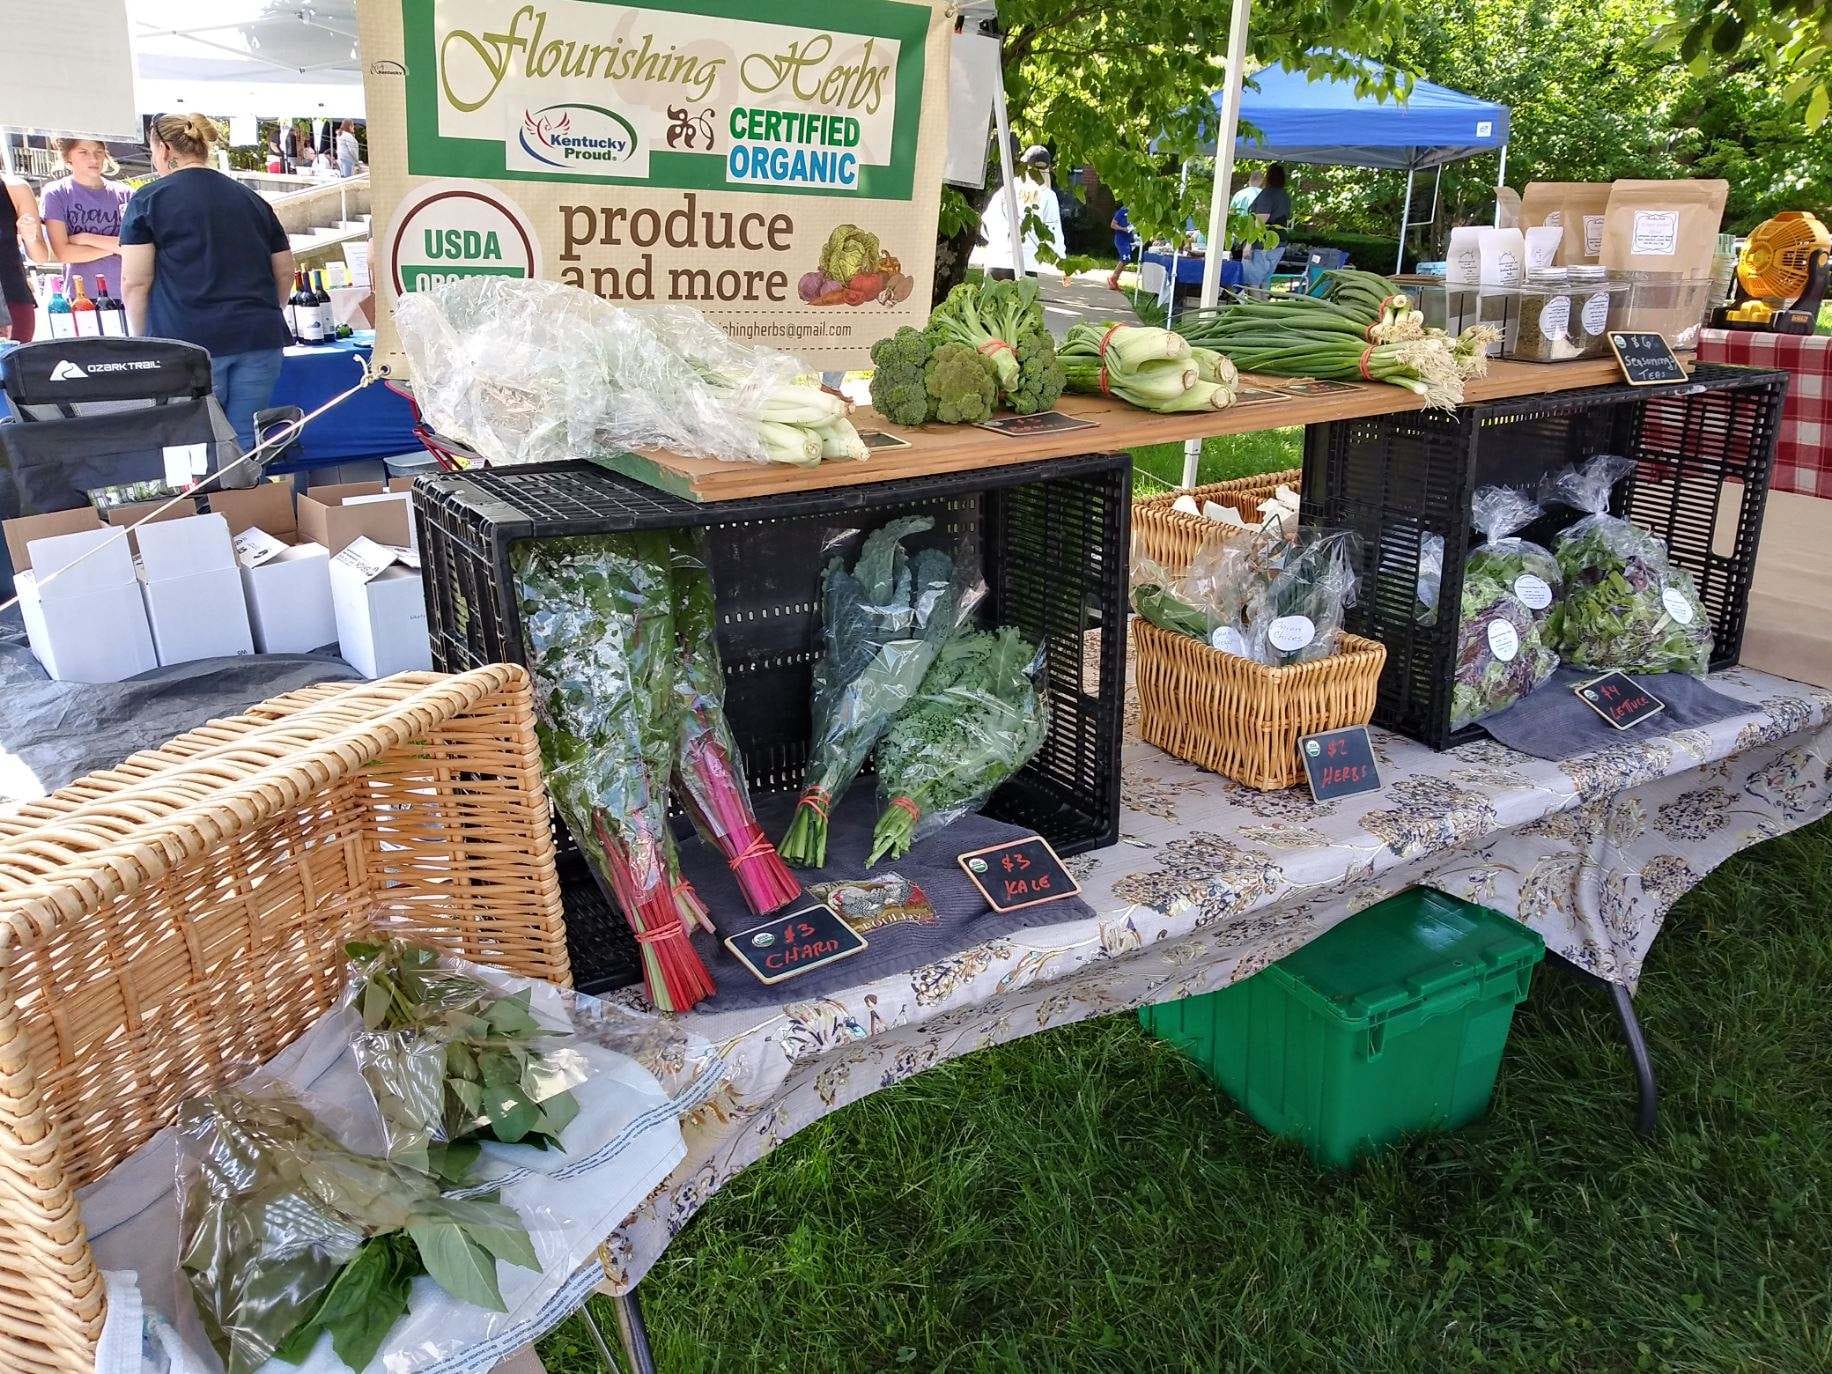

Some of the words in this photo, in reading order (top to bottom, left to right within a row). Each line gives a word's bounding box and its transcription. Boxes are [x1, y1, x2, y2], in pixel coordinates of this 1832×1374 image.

[440, 5, 726, 113] Flourishing
[740, 34, 890, 115] Herbs
[729, 107, 861, 147] CERTIFIED
[550, 134, 627, 152] Kentucky
[729, 145, 857, 185] ORGANIC
[559, 192, 794, 262] produce
[424, 229, 502, 260] USDA
[560, 253, 656, 301] and
[668, 268, 788, 301] more
[1322, 765, 1367, 788] HERBS
[1001, 853, 1031, 872] $3
[1004, 874, 1050, 900] KALE
[784, 923, 816, 944] $3
[765, 940, 839, 969] CHARD
